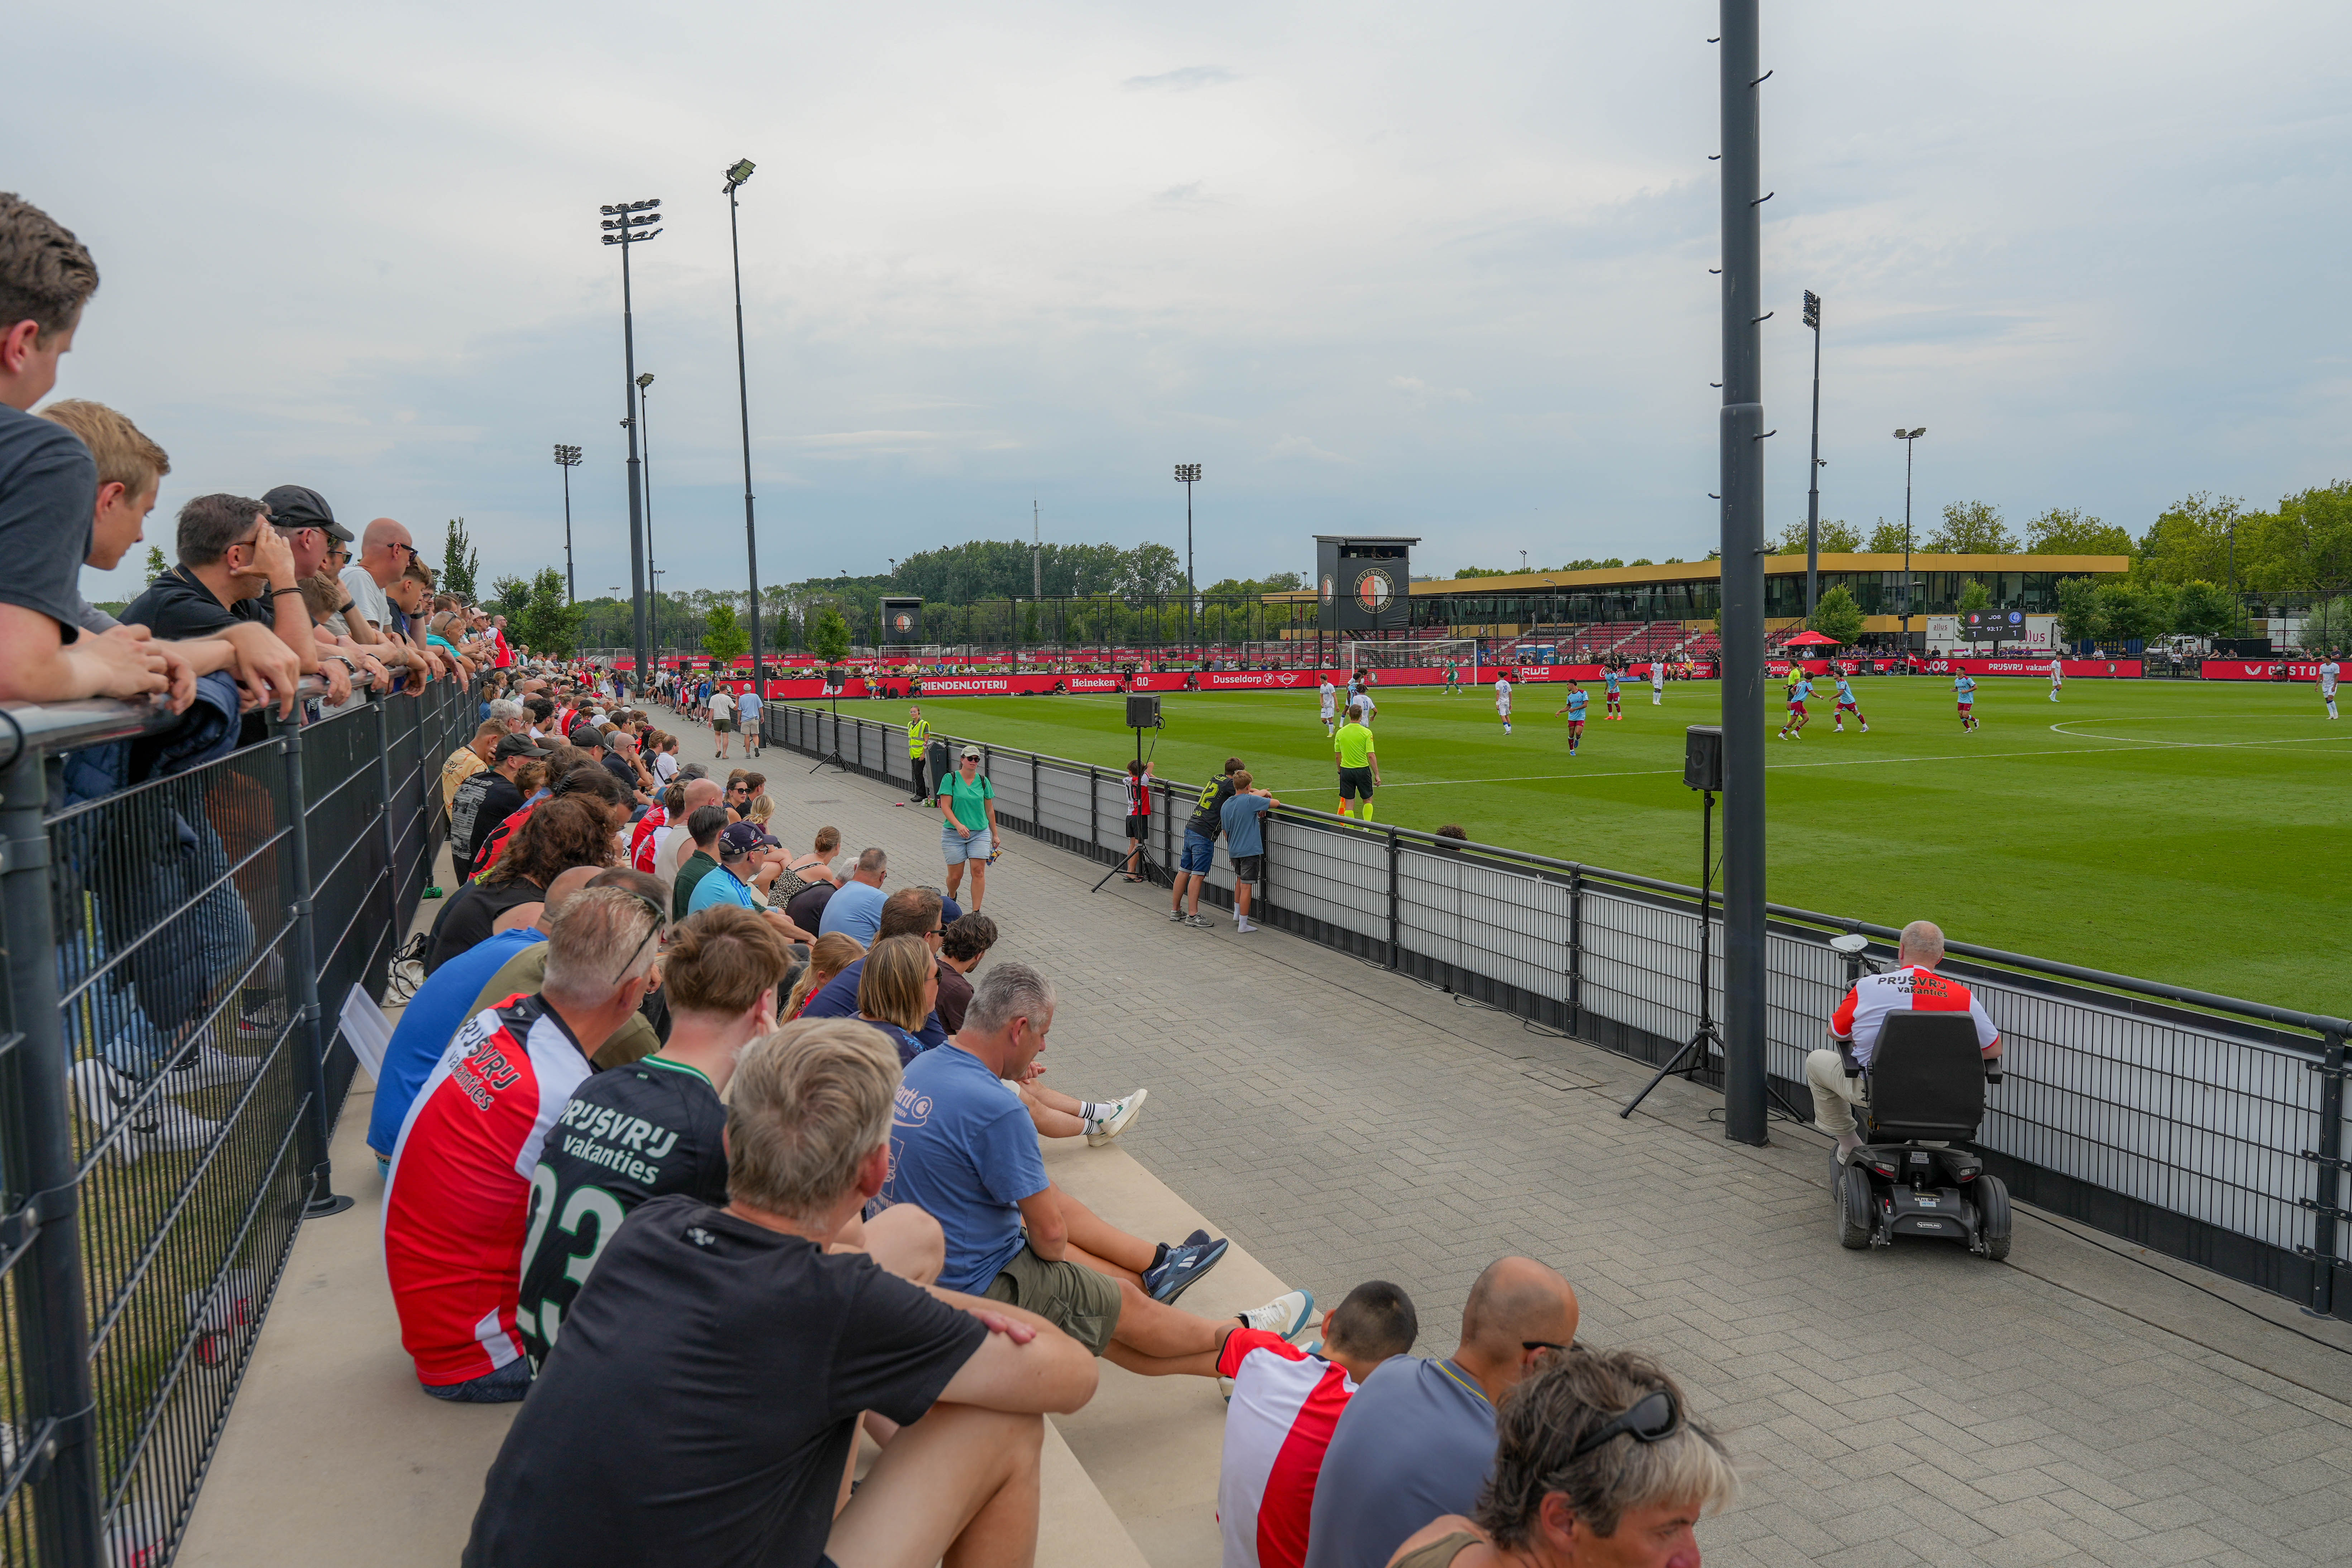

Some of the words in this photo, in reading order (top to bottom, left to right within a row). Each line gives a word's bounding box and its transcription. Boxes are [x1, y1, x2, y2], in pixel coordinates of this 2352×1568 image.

[1357, 570, 1391, 585] FEYENOORD
[1357, 596, 1392, 612] ROTTERDAM
[2019, 630, 2045, 642] llus
[1522, 667, 1549, 675] RWG
[921, 680, 1007, 691] RIENDENLOTERIJ
[1072, 678, 1115, 687] Heineken
[1136, 677, 1149, 686] 0.0
[1213, 675, 1262, 685] Dusseldorp
[1363, 701, 1368, 710] 19
[1897, 986, 1948, 998] vakanties
[448, 1050, 495, 1111] vakanties
[562, 1134, 660, 1185] vakanties
